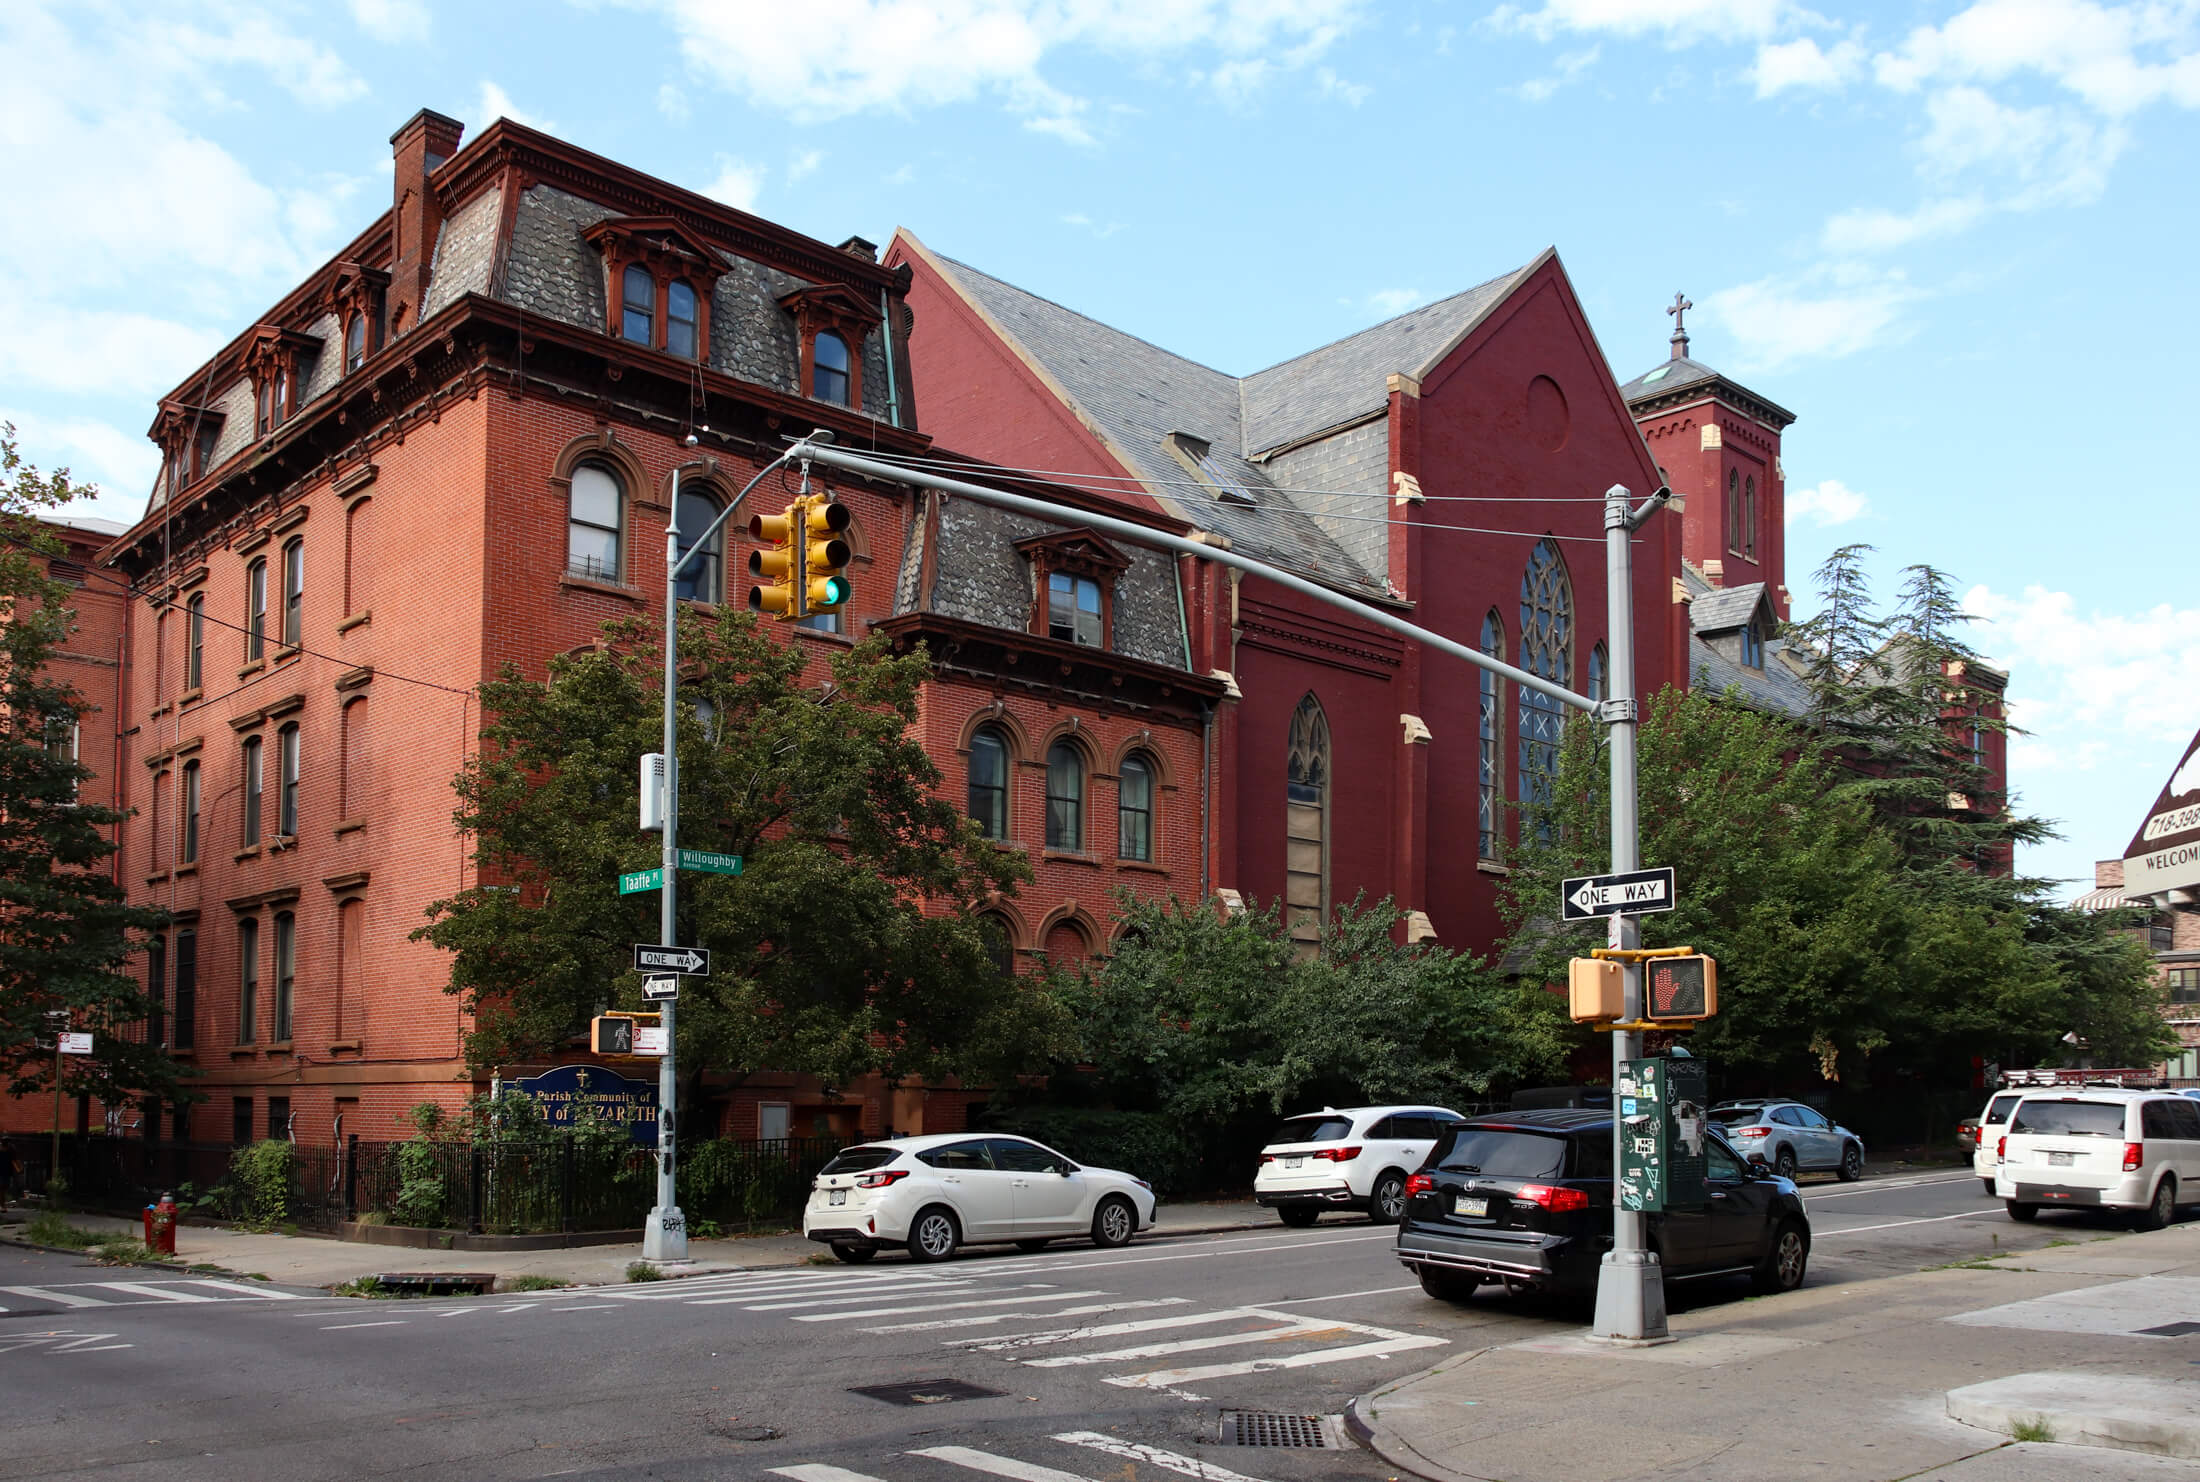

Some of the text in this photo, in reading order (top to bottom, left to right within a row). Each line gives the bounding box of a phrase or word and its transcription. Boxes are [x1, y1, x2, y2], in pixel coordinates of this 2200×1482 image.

[683, 851, 736, 870] Willoughby
[2146, 846, 2200, 870] WELCOM
[625, 874, 650, 891] Taaffe
[1580, 882, 1657, 905] ONE WAY
[646, 953, 698, 966] ONE WAY
[647, 982, 673, 992] ONE WAY
[536, 1090, 571, 1102] Parish
[640, 1092, 651, 1102] of
[555, 1106, 569, 1121] of
[573, 1104, 656, 1122] ZARTH
